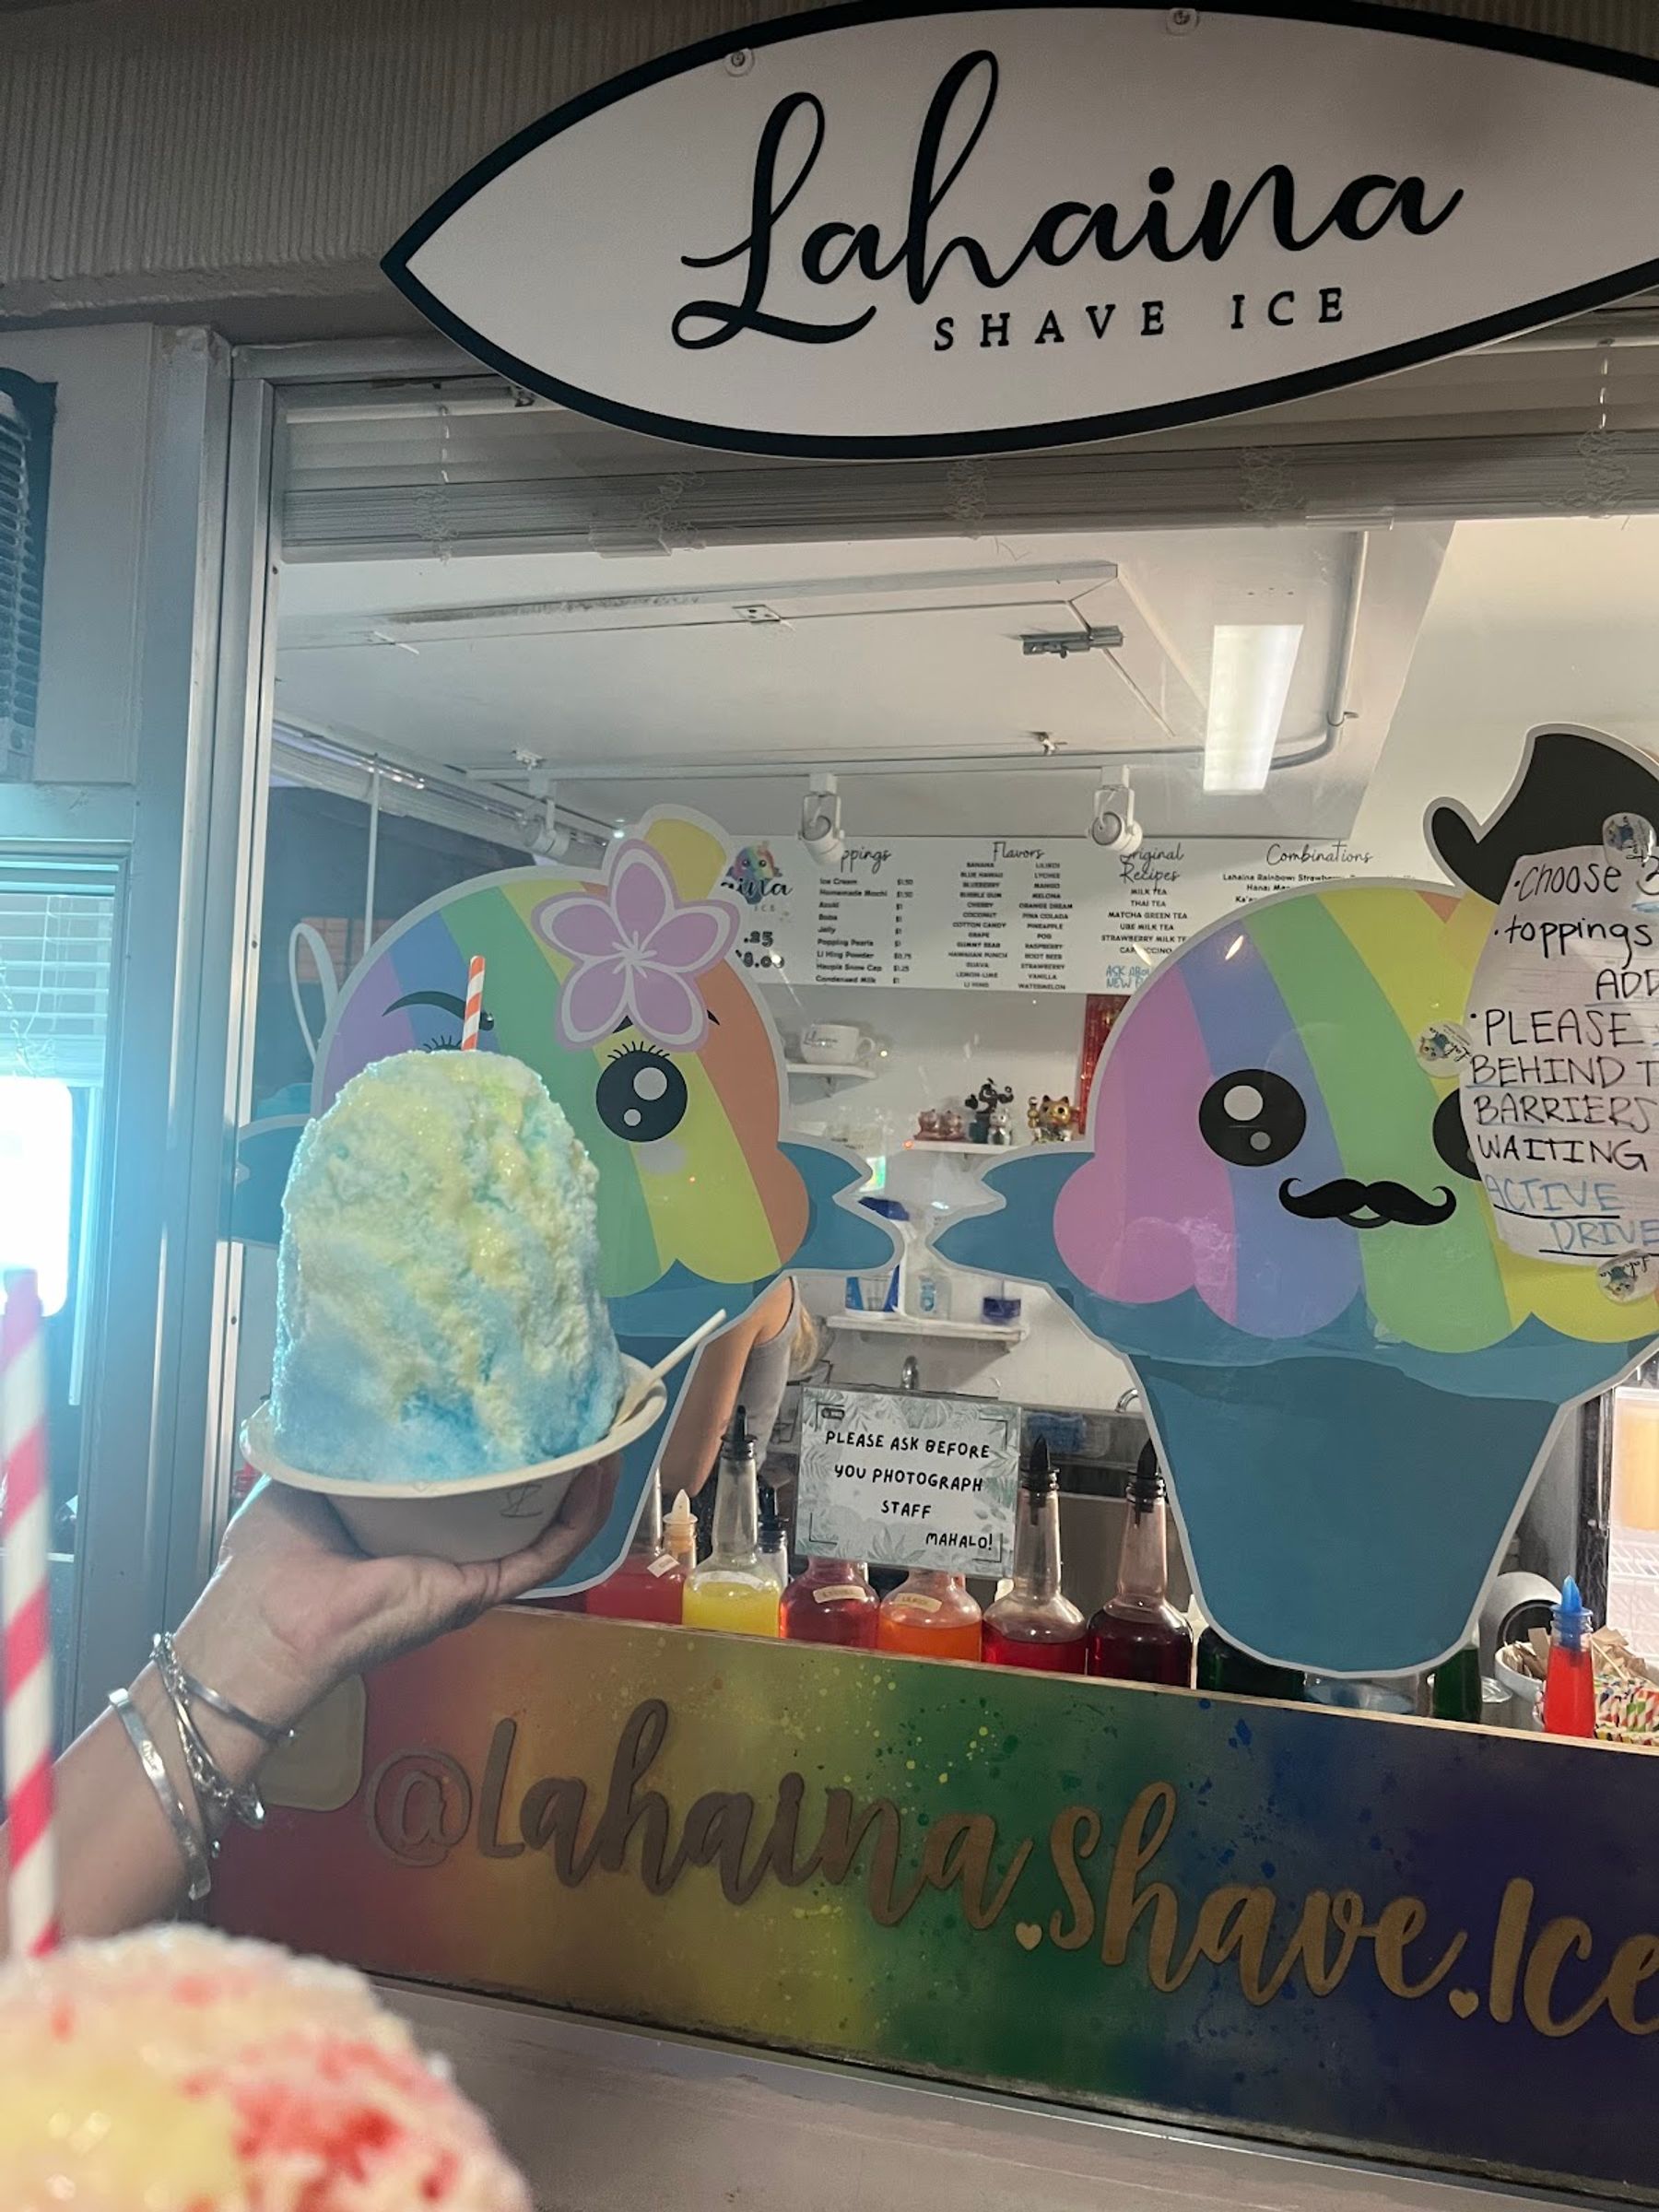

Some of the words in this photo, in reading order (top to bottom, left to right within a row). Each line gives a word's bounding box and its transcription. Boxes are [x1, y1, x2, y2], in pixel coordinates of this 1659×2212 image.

[672, 50, 1465, 349] Lahaina
[934, 300, 1164, 351] SHAVE
[1230, 287, 1344, 330] ICE
[841, 847, 891, 873] ppings
[993, 841, 1045, 862] Flavors
[1266, 841, 1373, 865] Combinations
[1119, 861, 1180, 891] Recipes
[819, 888, 862, 897] Homemade
[818, 938, 849, 947] Popping
[1504, 913, 1653, 970] toppings
[1485, 1008, 1644, 1047] PLEASE
[1472, 1054, 1625, 1088] BEHIND
[1474, 1092, 1657, 1133] BARRIERS
[1477, 1135, 1648, 1171] WAITING
[1485, 1174, 1625, 1211] ACTIVE
[826, 1430, 884, 1448] PLEASE
[890, 1437, 919, 1451] ASK
[925, 1439, 990, 1458] BEFORE
[834, 1465, 866, 1479] YOU
[873, 1468, 983, 1491] PHOTOGRAPH
[881, 1500, 932, 1519] STAFF
[925, 1533, 994, 1550] MAHALO!
